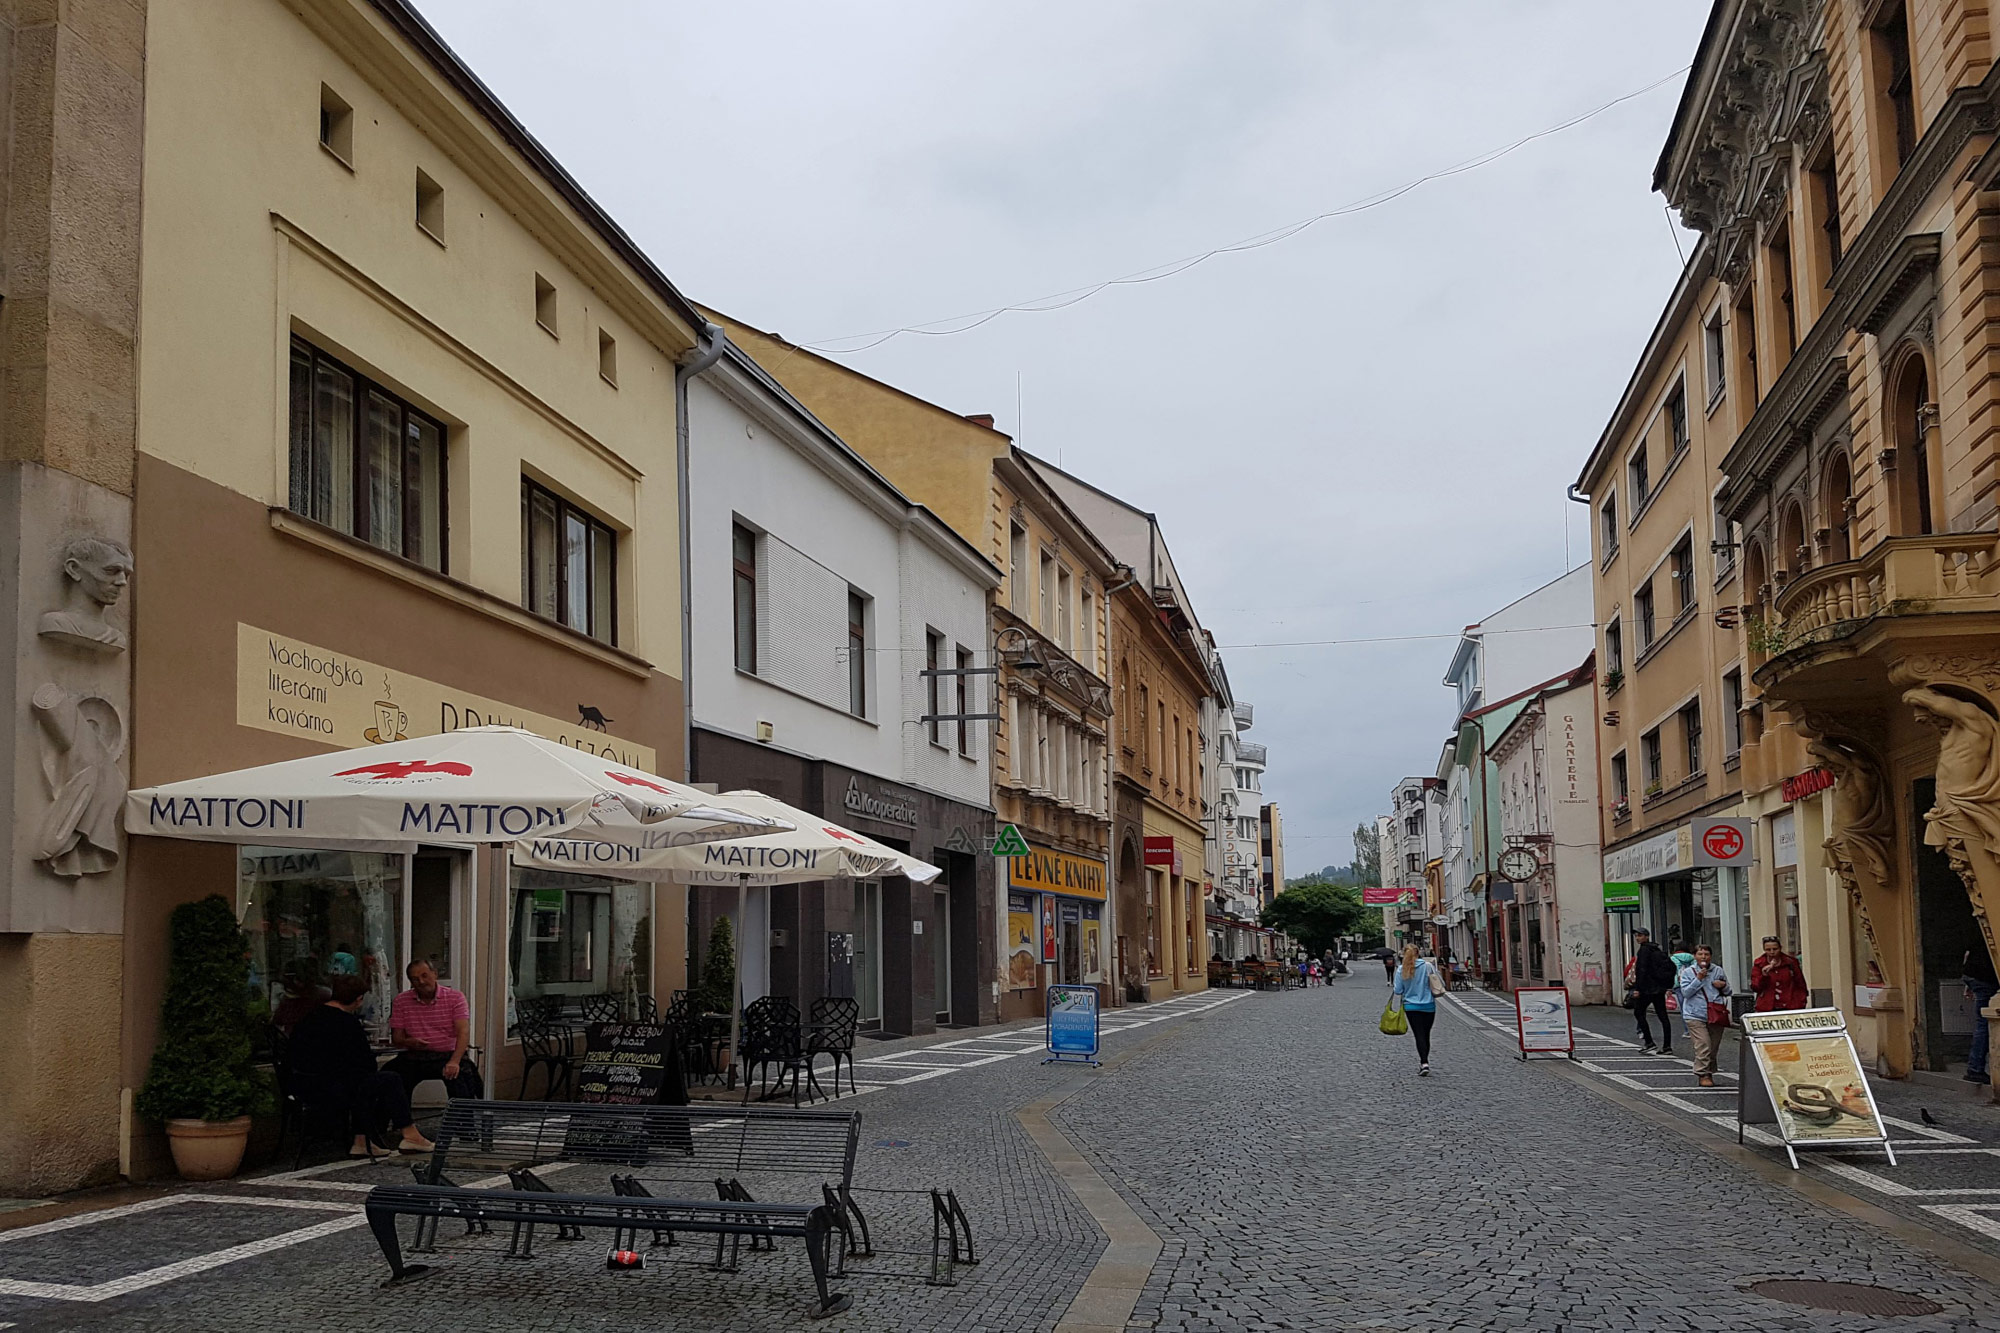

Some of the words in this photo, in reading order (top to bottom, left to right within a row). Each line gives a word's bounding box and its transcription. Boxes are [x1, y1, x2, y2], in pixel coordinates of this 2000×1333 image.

[268, 637, 363, 686] Náchodská
[268, 669, 328, 704] literární
[268, 699, 334, 734] kavárna
[1563, 715, 1578, 799] GALANTERIE
[150, 796, 304, 829] MATTONI
[861, 792, 918, 824] Kooperativa
[531, 841, 641, 862] MATTONI
[704, 845, 817, 869] MATTONI
[1015, 852, 1062, 886] LEVNÉ
[1065, 860, 1102, 893] KNIHY
[1750, 1019, 1793, 1031] ELEKTRO
[1795, 1014, 1838, 1029] OTEVŘENO
